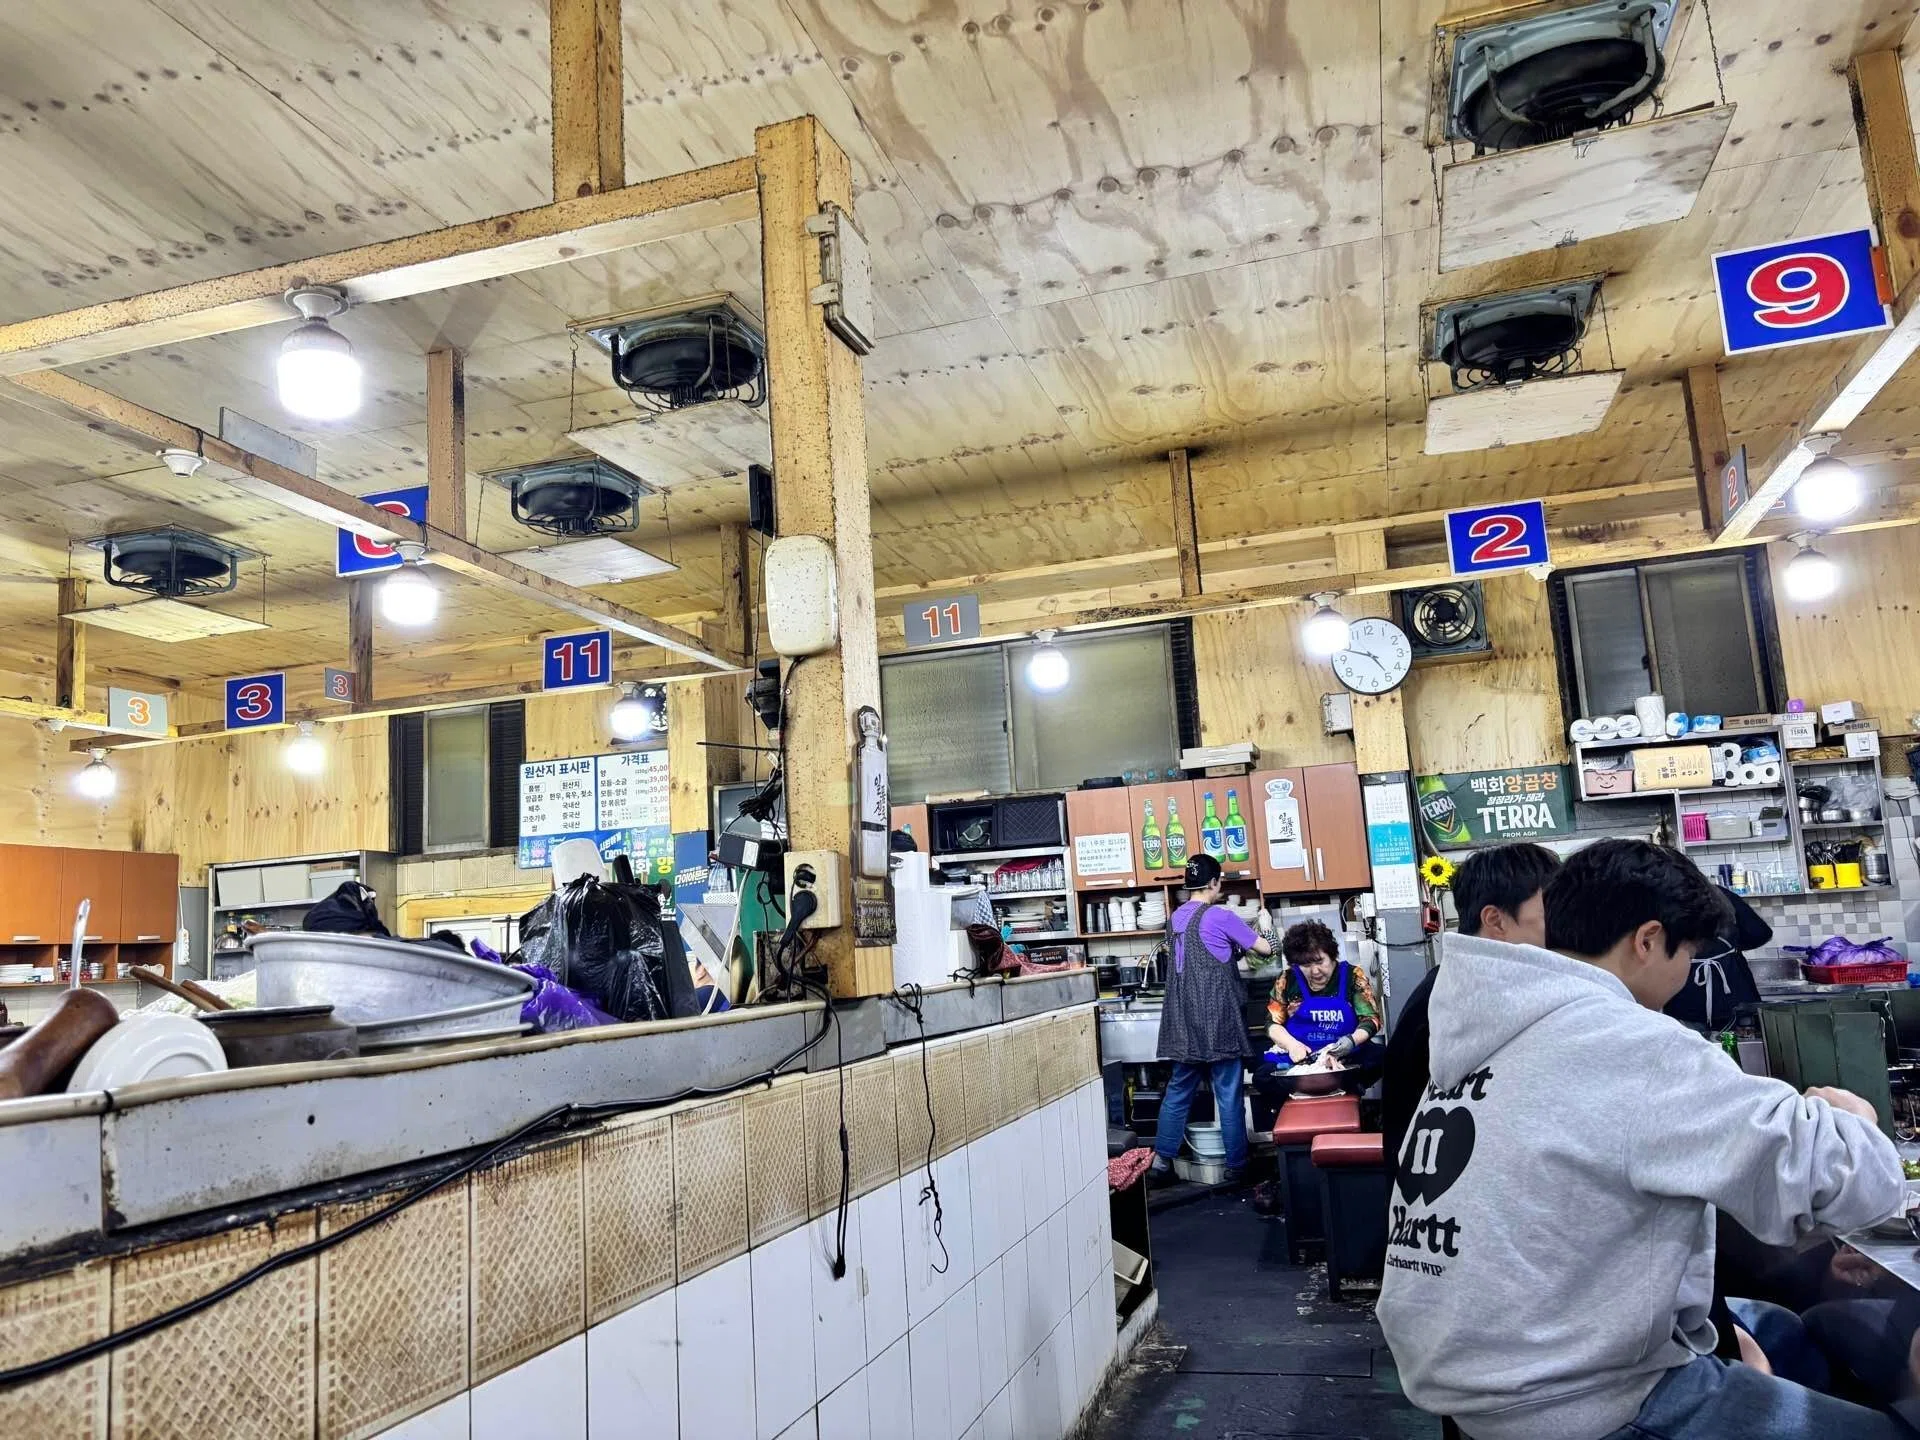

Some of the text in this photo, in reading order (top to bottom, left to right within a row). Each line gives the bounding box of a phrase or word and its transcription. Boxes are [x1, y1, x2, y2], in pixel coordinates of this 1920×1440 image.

[1746, 252, 1850, 328] 9
[1728, 466, 1738, 511] 2
[1468, 514, 1531, 563] 2
[922, 602, 961, 637] 11
[1364, 625, 1374, 636] 12
[1390, 636, 1398, 645] 2
[1396, 648, 1404, 658] 3
[552, 638, 600, 681] 11
[1340, 655, 1347, 664] 9
[1345, 667, 1353, 677] 8
[1394, 662, 1401, 671] 4
[1357, 676, 1364, 685] 7
[1371, 677, 1379, 687] 6
[1385, 672, 1392, 682] 5
[332, 675, 349, 697] 3
[235, 682, 273, 721] 3
[127, 697, 151, 726] 3
[621, 753, 649, 766] 가격표
[525, 760, 591, 779] 원산지 표시판
[649, 764, 669, 773] 45,00
[649, 775, 669, 783] 39,00
[1470, 772, 1558, 795] 백화양곱창
[562, 781, 580, 789] 원산지
[649, 785, 669, 794] 39,00
[562, 801, 580, 809] 국내산
[1420, 796, 1457, 820] TERRA
[1477, 803, 1556, 834] TERRA
[562, 821, 580, 829] 국내산
[1310, 1010, 1344, 1022] TERRA
[1318, 1022, 1339, 1030] Light
[1421, 1262, 1443, 1276] WIP
